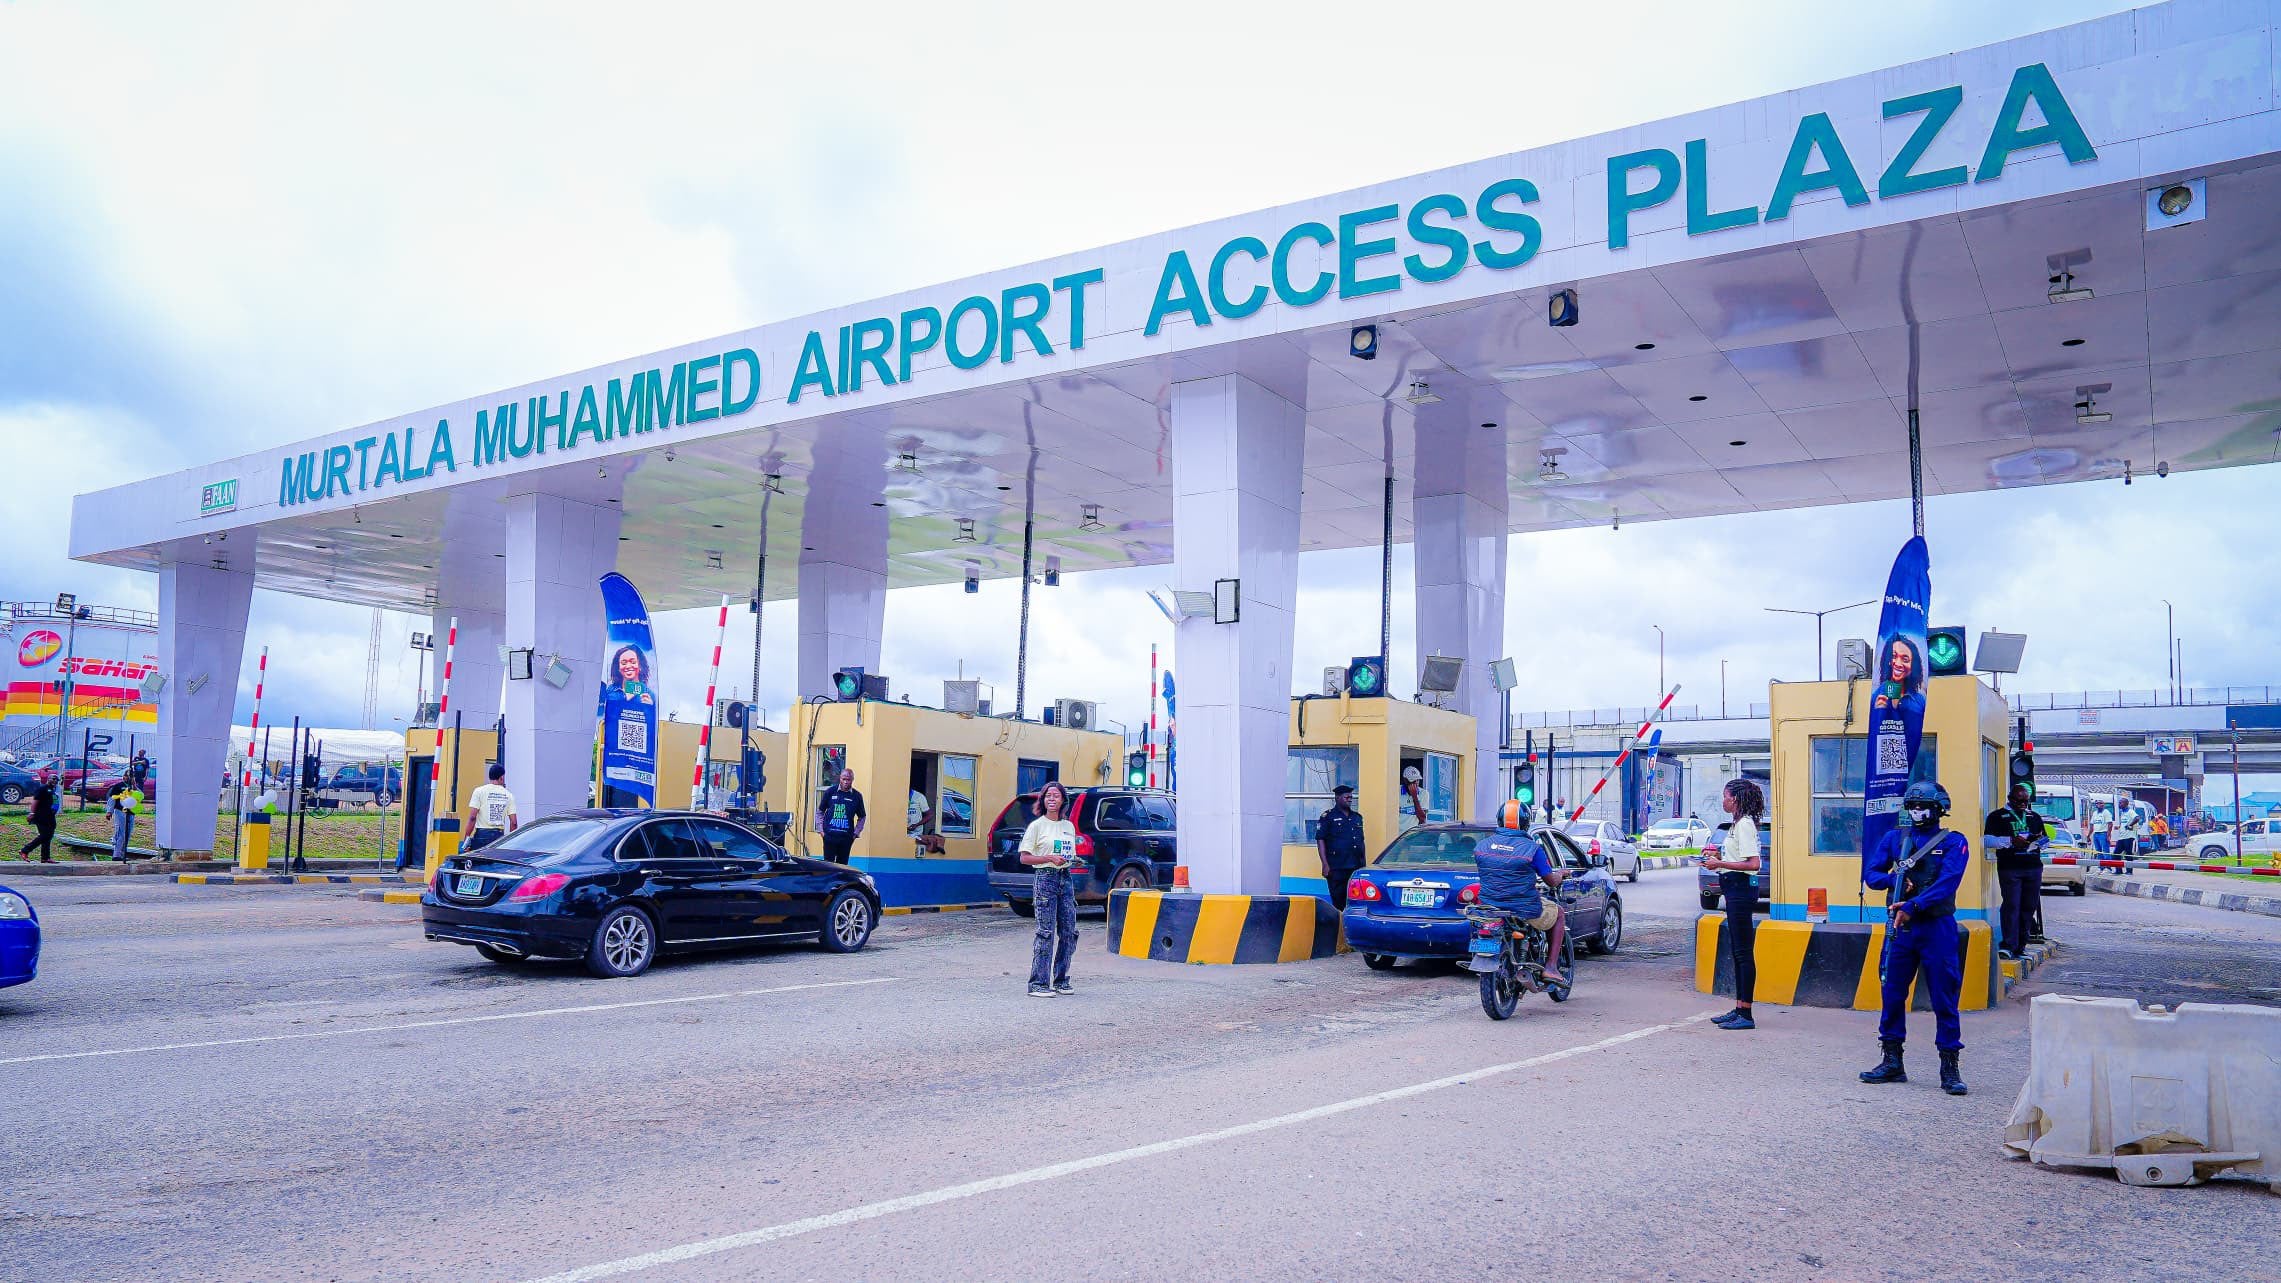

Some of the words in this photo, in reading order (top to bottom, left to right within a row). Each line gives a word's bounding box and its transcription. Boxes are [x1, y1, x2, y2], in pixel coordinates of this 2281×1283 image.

[278, 418, 456, 506] MURTALA
[473, 347, 761, 467] MUHAMMED
[787, 267, 1104, 403] AIRPORT
[1144, 178, 1542, 336] ACCESS
[1607, 63, 2098, 250] PLAZA
